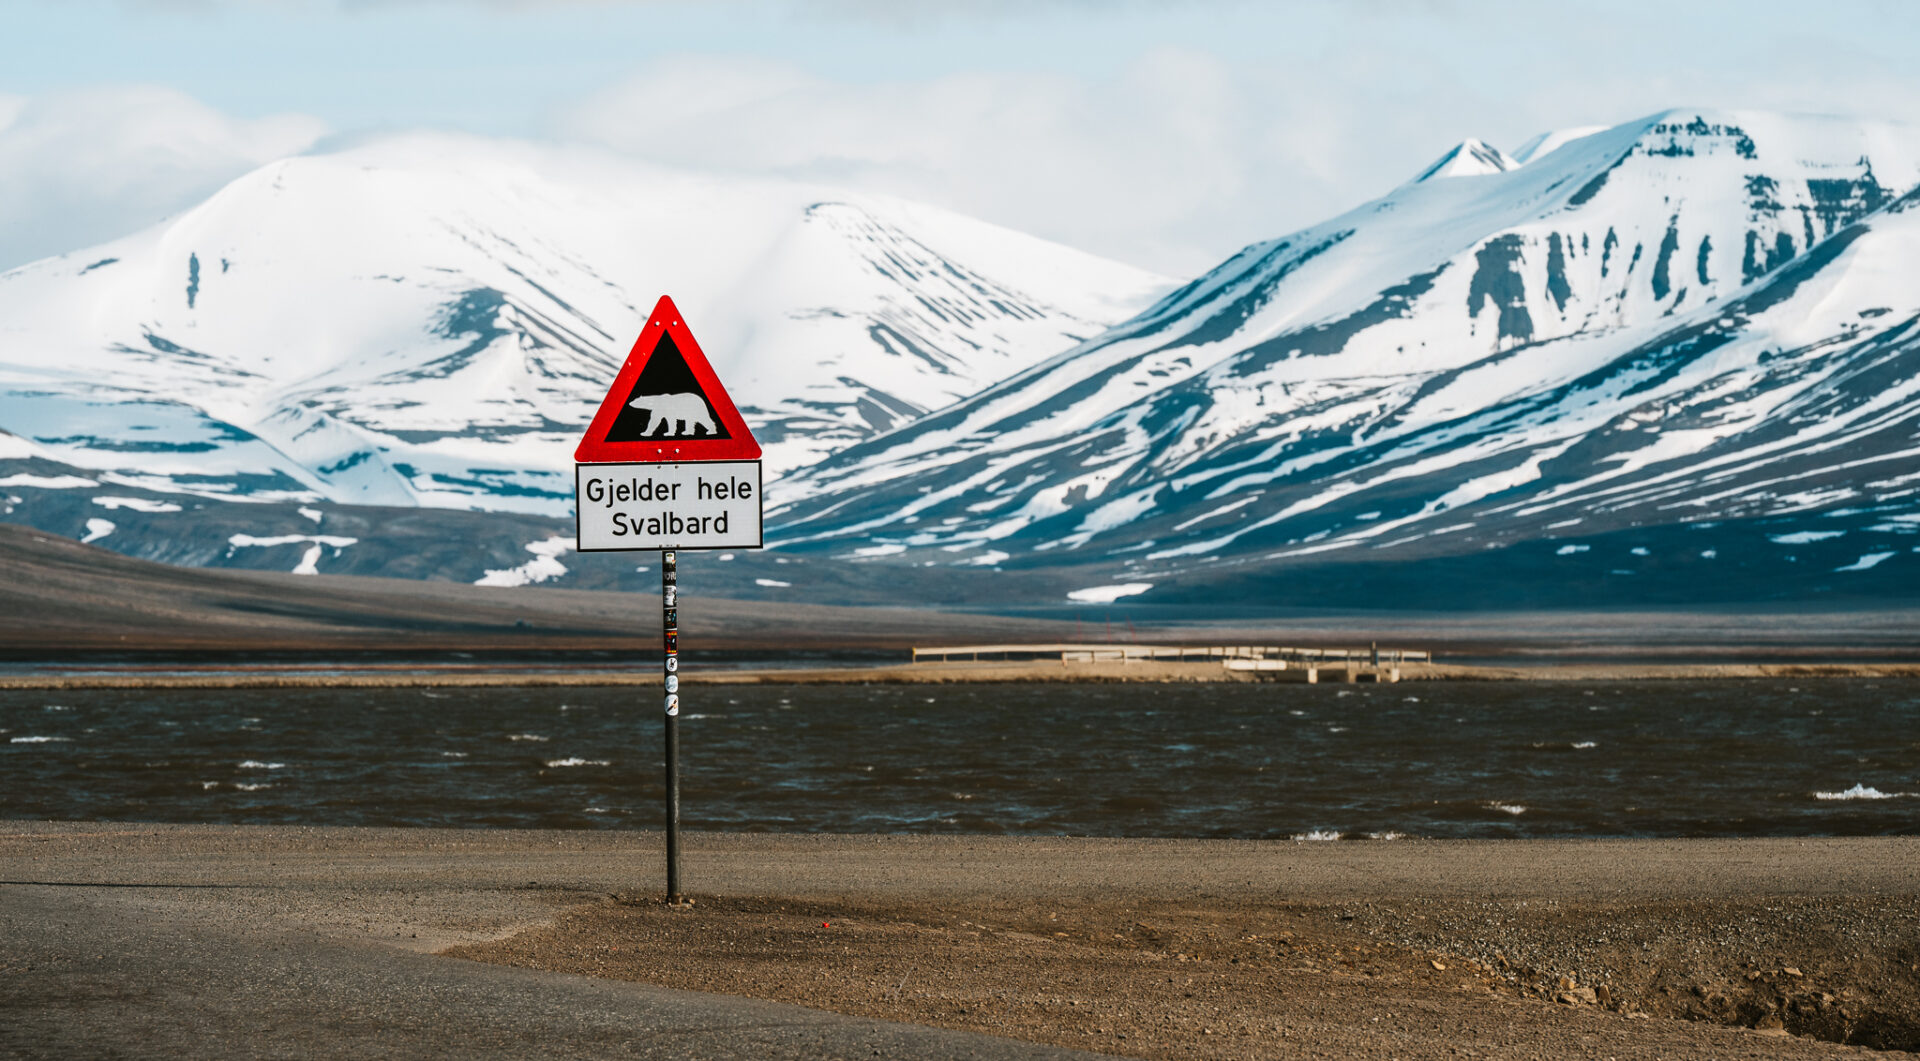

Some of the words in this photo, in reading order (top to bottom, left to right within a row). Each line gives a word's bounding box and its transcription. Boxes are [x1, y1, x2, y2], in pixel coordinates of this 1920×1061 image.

[586, 477, 682, 509] Gjelder
[698, 475, 753, 500] hele
[612, 510, 729, 537] Svalbard
